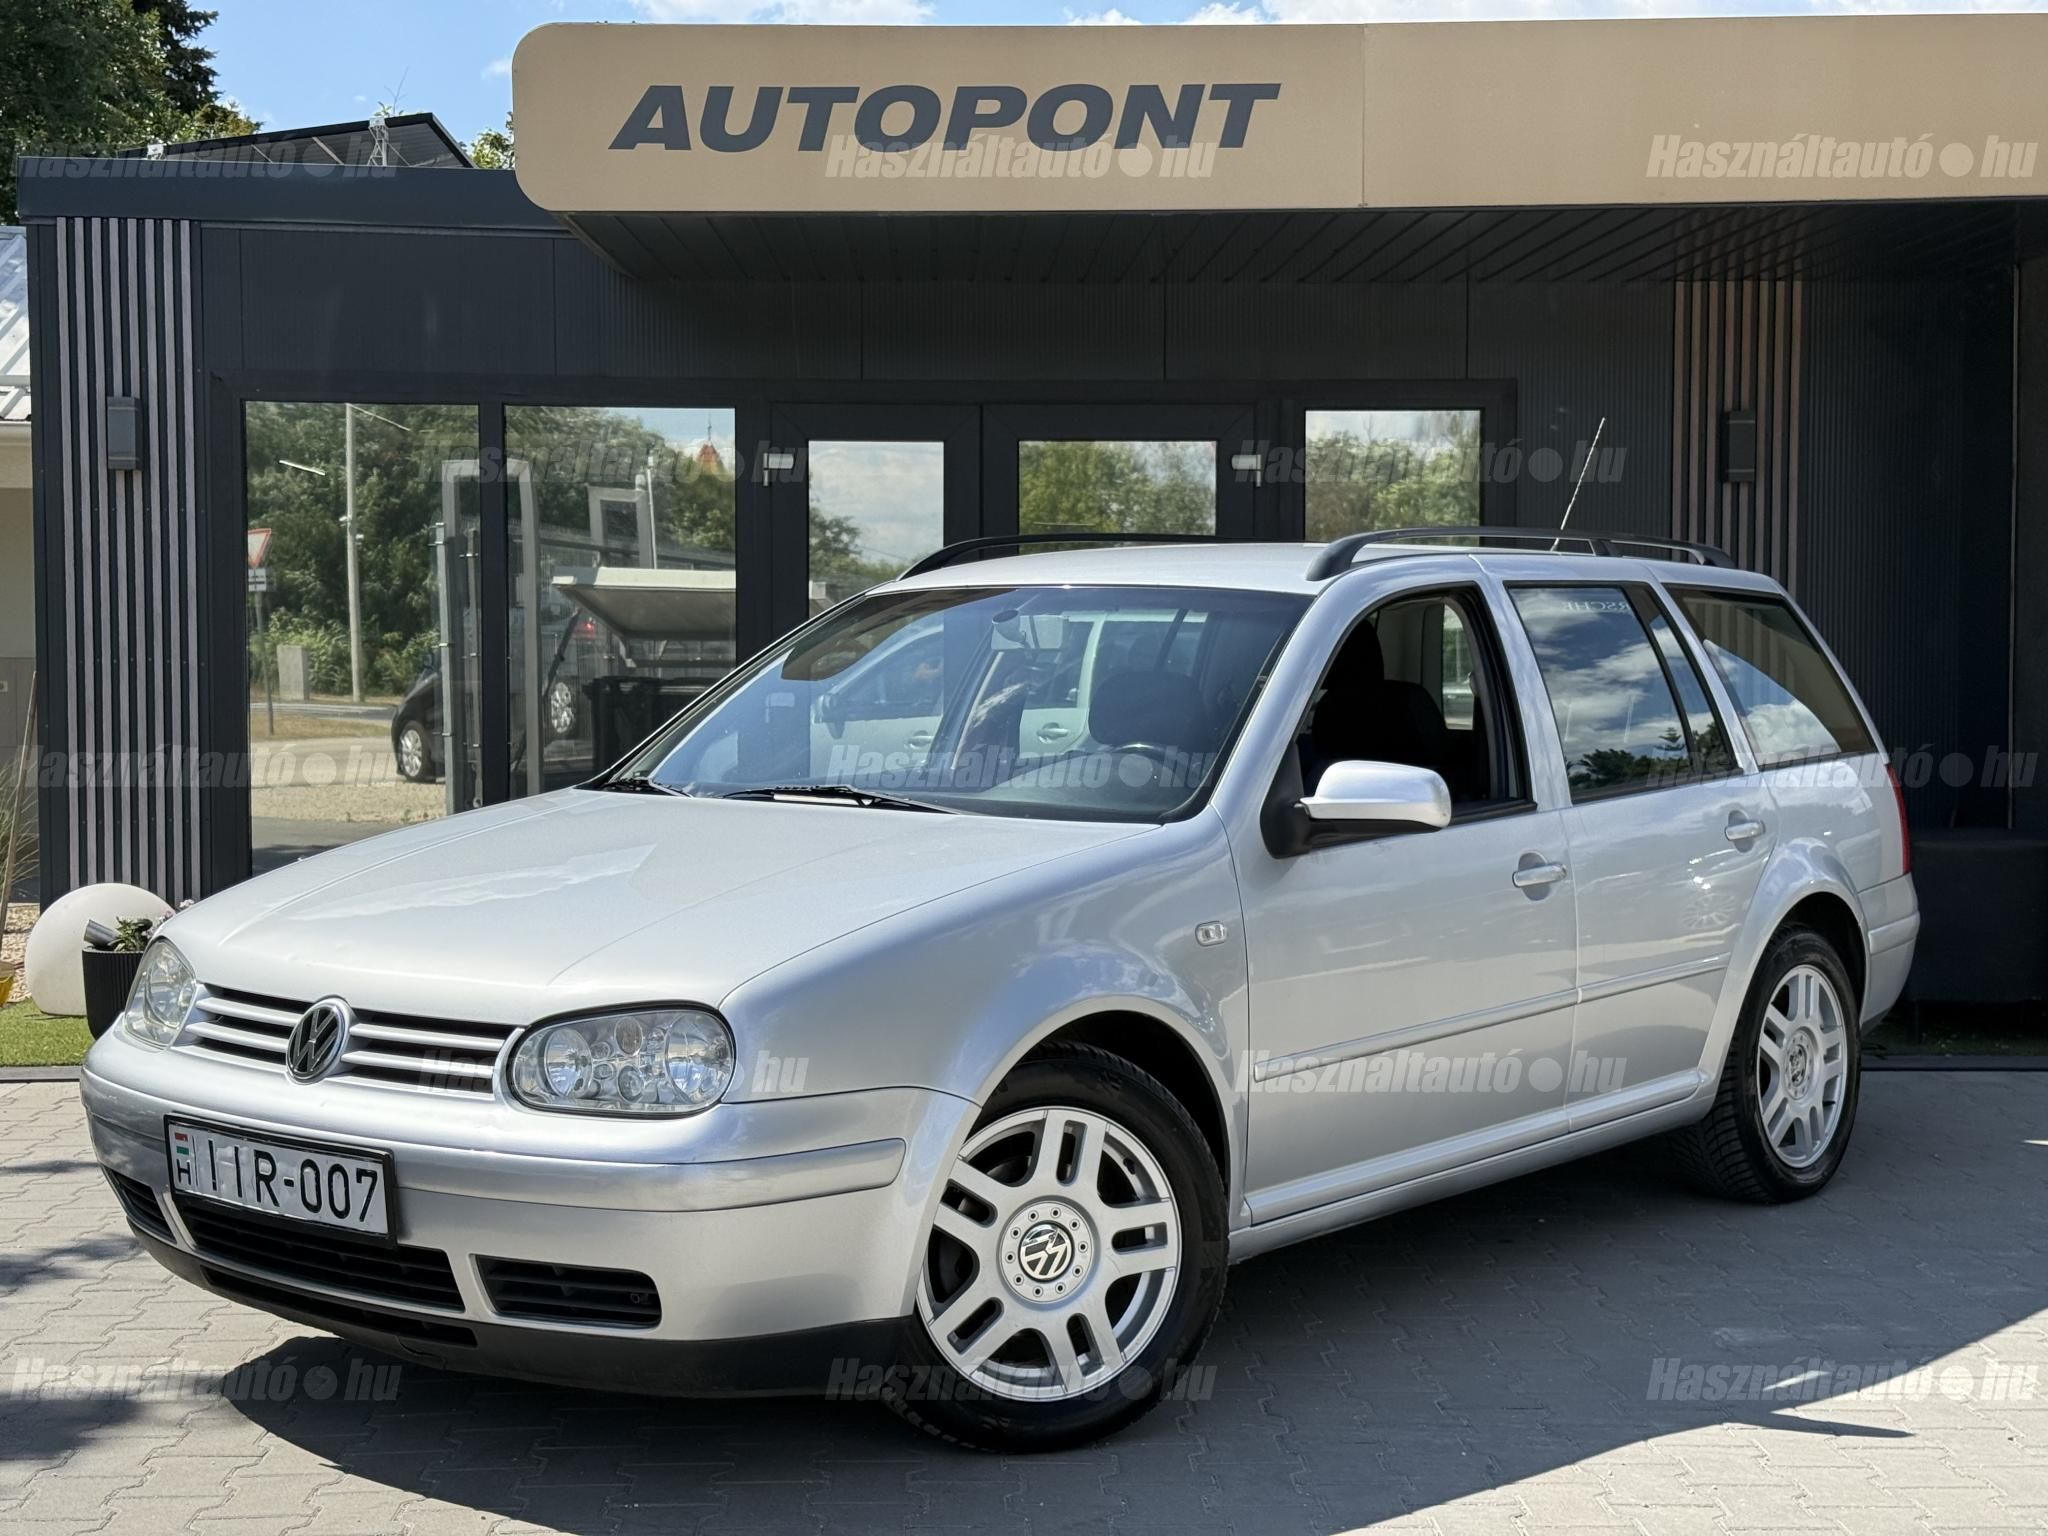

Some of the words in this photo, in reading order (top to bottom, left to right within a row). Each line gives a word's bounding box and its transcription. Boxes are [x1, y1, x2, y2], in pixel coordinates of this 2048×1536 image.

[609, 83, 1282, 153] AUTOPONT
[176, 1159, 192, 1186] H
[208, 1138, 378, 1223] IIR-007
